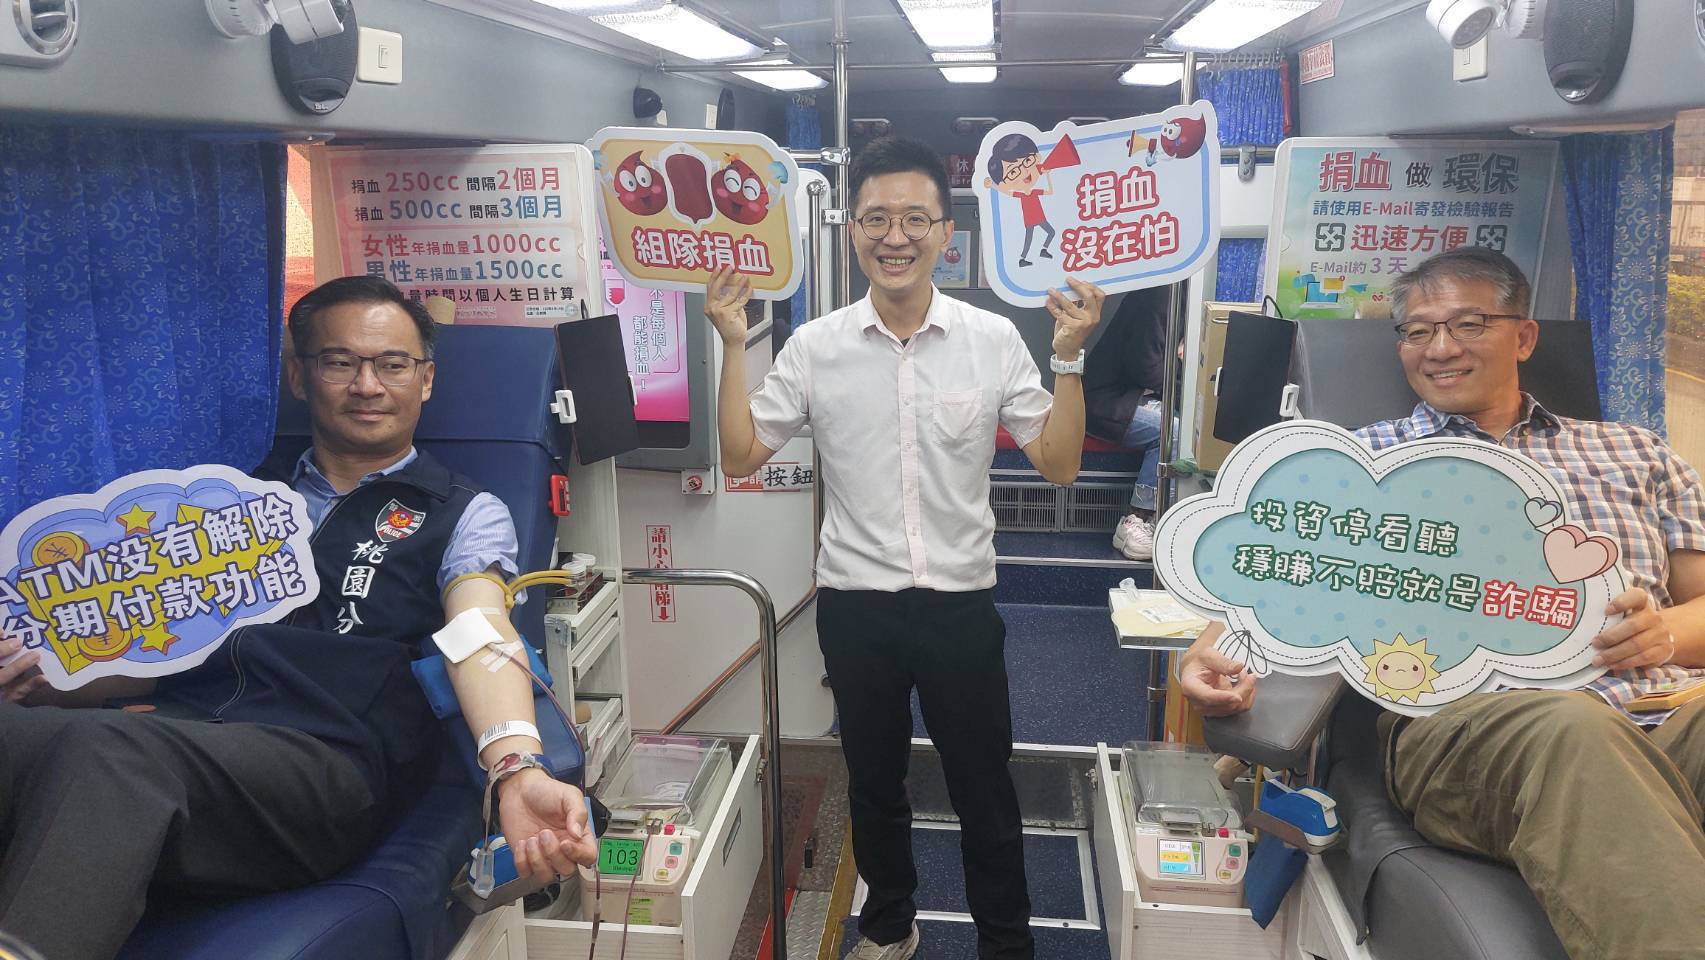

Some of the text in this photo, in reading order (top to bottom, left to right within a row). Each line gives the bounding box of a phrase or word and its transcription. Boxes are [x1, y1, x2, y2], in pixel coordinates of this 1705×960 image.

[351, 167, 560, 194] 捐血 250cc 間隔2個月
[1080, 168, 1157, 218] 捐血
[1319, 151, 1519, 193] 捐血 做 環保
[354, 195, 562, 222] 捐血 500cc 間隔3個月
[633, 229, 772, 274] 組隊捐血
[1063, 215, 1178, 269] 沒在怕
[1350, 224, 1469, 251] 迅速方便
[1370, 257, 1381, 274] 3
[1387, 256, 1408, 274] 天
[764, 465, 813, 487] 按鈕
[1251, 500, 1459, 557] 投資停看聽
[3, 552, 306, 648] 分期付款功能
[332, 540, 389, 634] 桃園分
[1234, 545, 1578, 629] 穩賺不賠就是詐騙
[608, 849, 638, 866] 103
